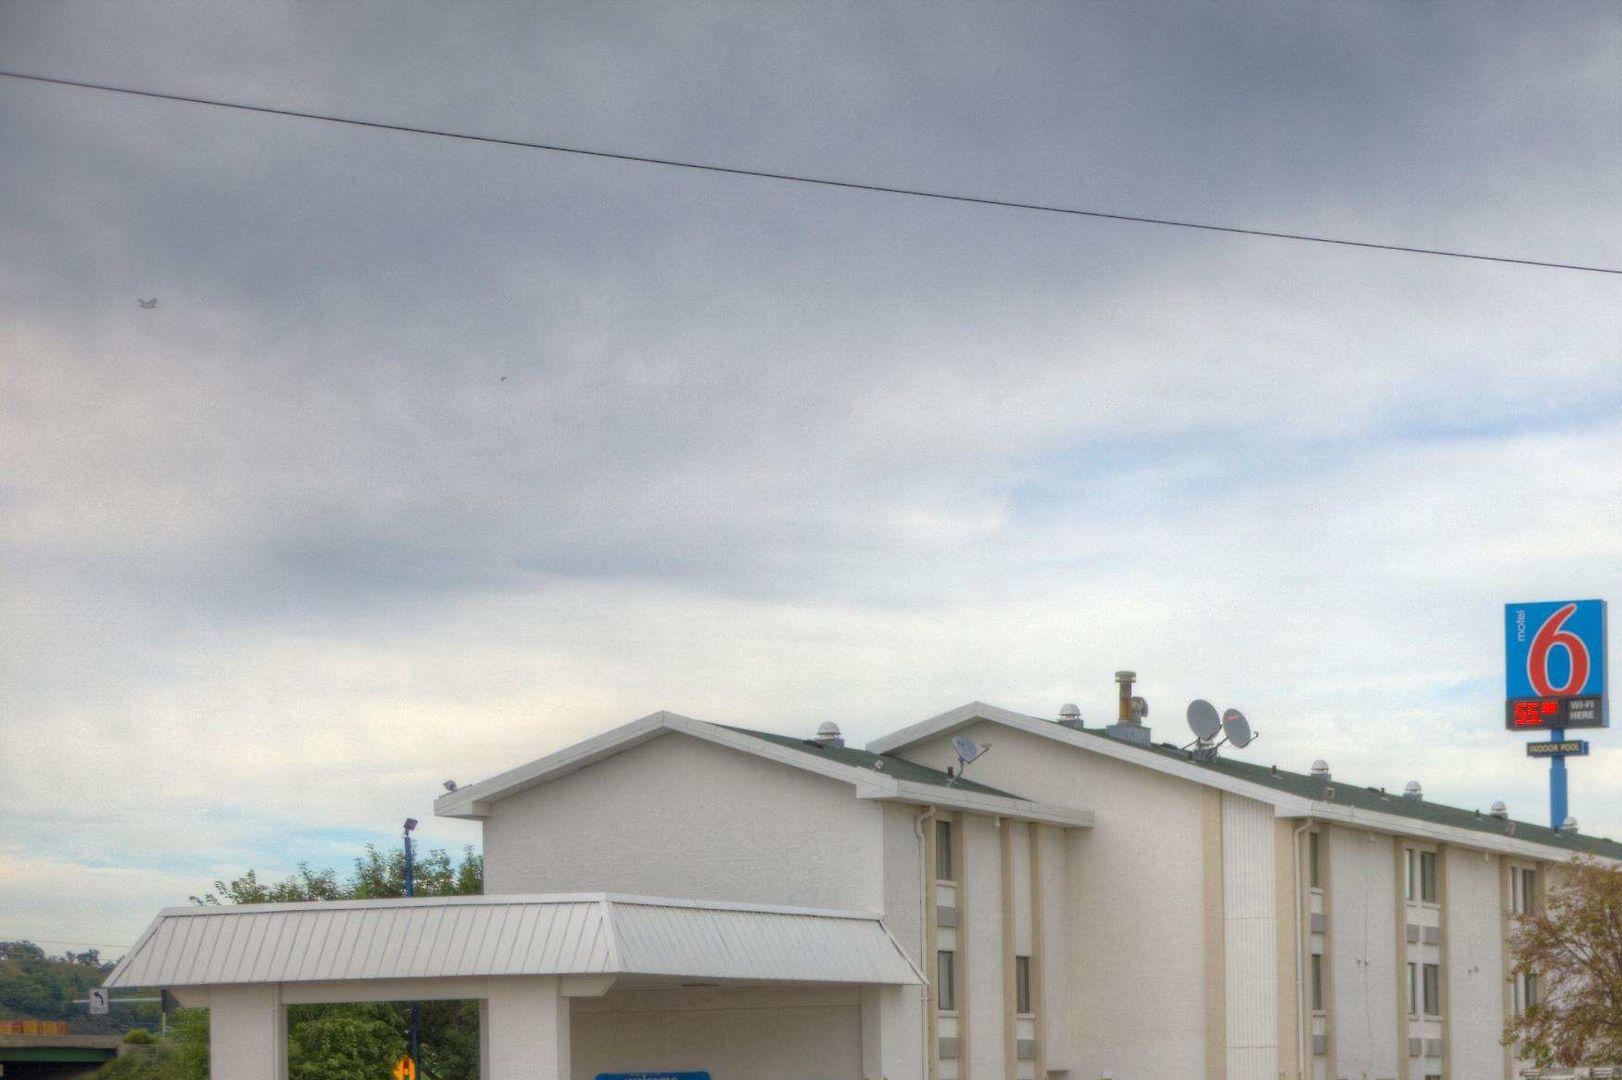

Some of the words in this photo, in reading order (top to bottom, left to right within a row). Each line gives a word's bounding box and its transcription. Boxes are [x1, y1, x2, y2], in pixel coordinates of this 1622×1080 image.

[1517, 610, 1526, 641] motel
[1527, 603, 1590, 697] 6
[1570, 710, 1595, 720] HERE
